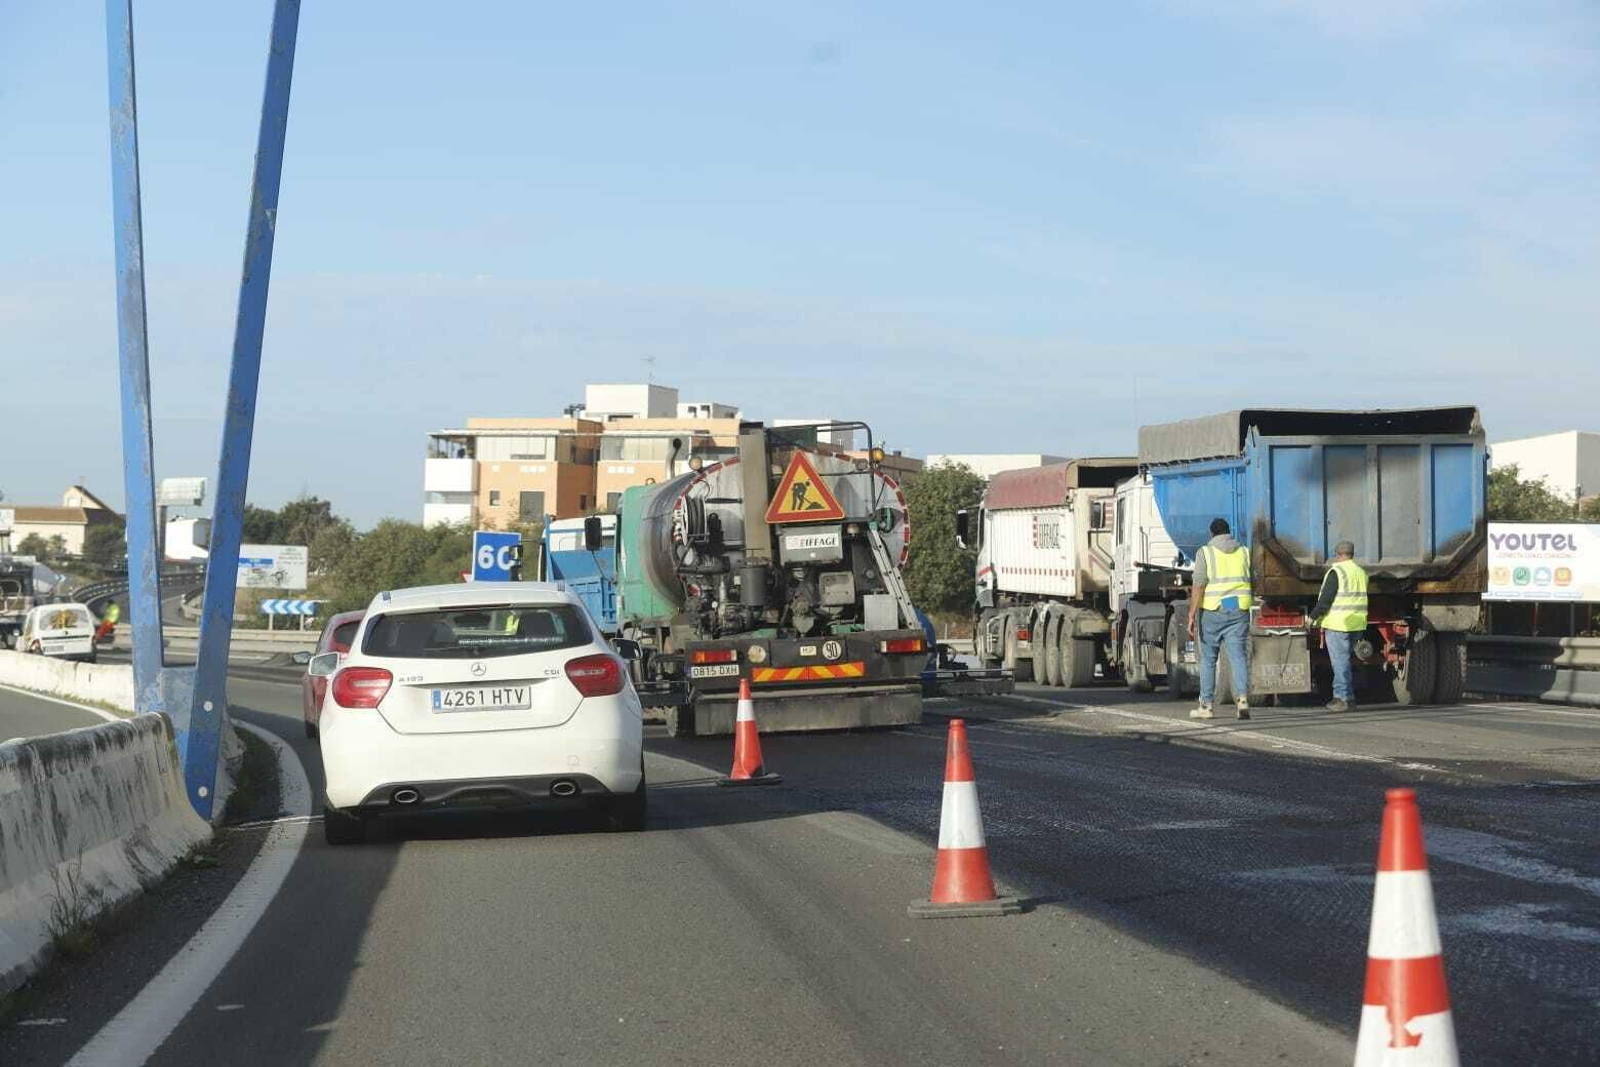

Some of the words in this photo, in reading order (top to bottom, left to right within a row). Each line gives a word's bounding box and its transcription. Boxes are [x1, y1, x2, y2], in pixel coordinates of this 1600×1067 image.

[825, 642, 838, 658] 90
[693, 667, 717, 677] 0815
[719, 665, 738, 675] DXH
[443, 689, 485, 707] 4261
[492, 688, 525, 705] HTV
